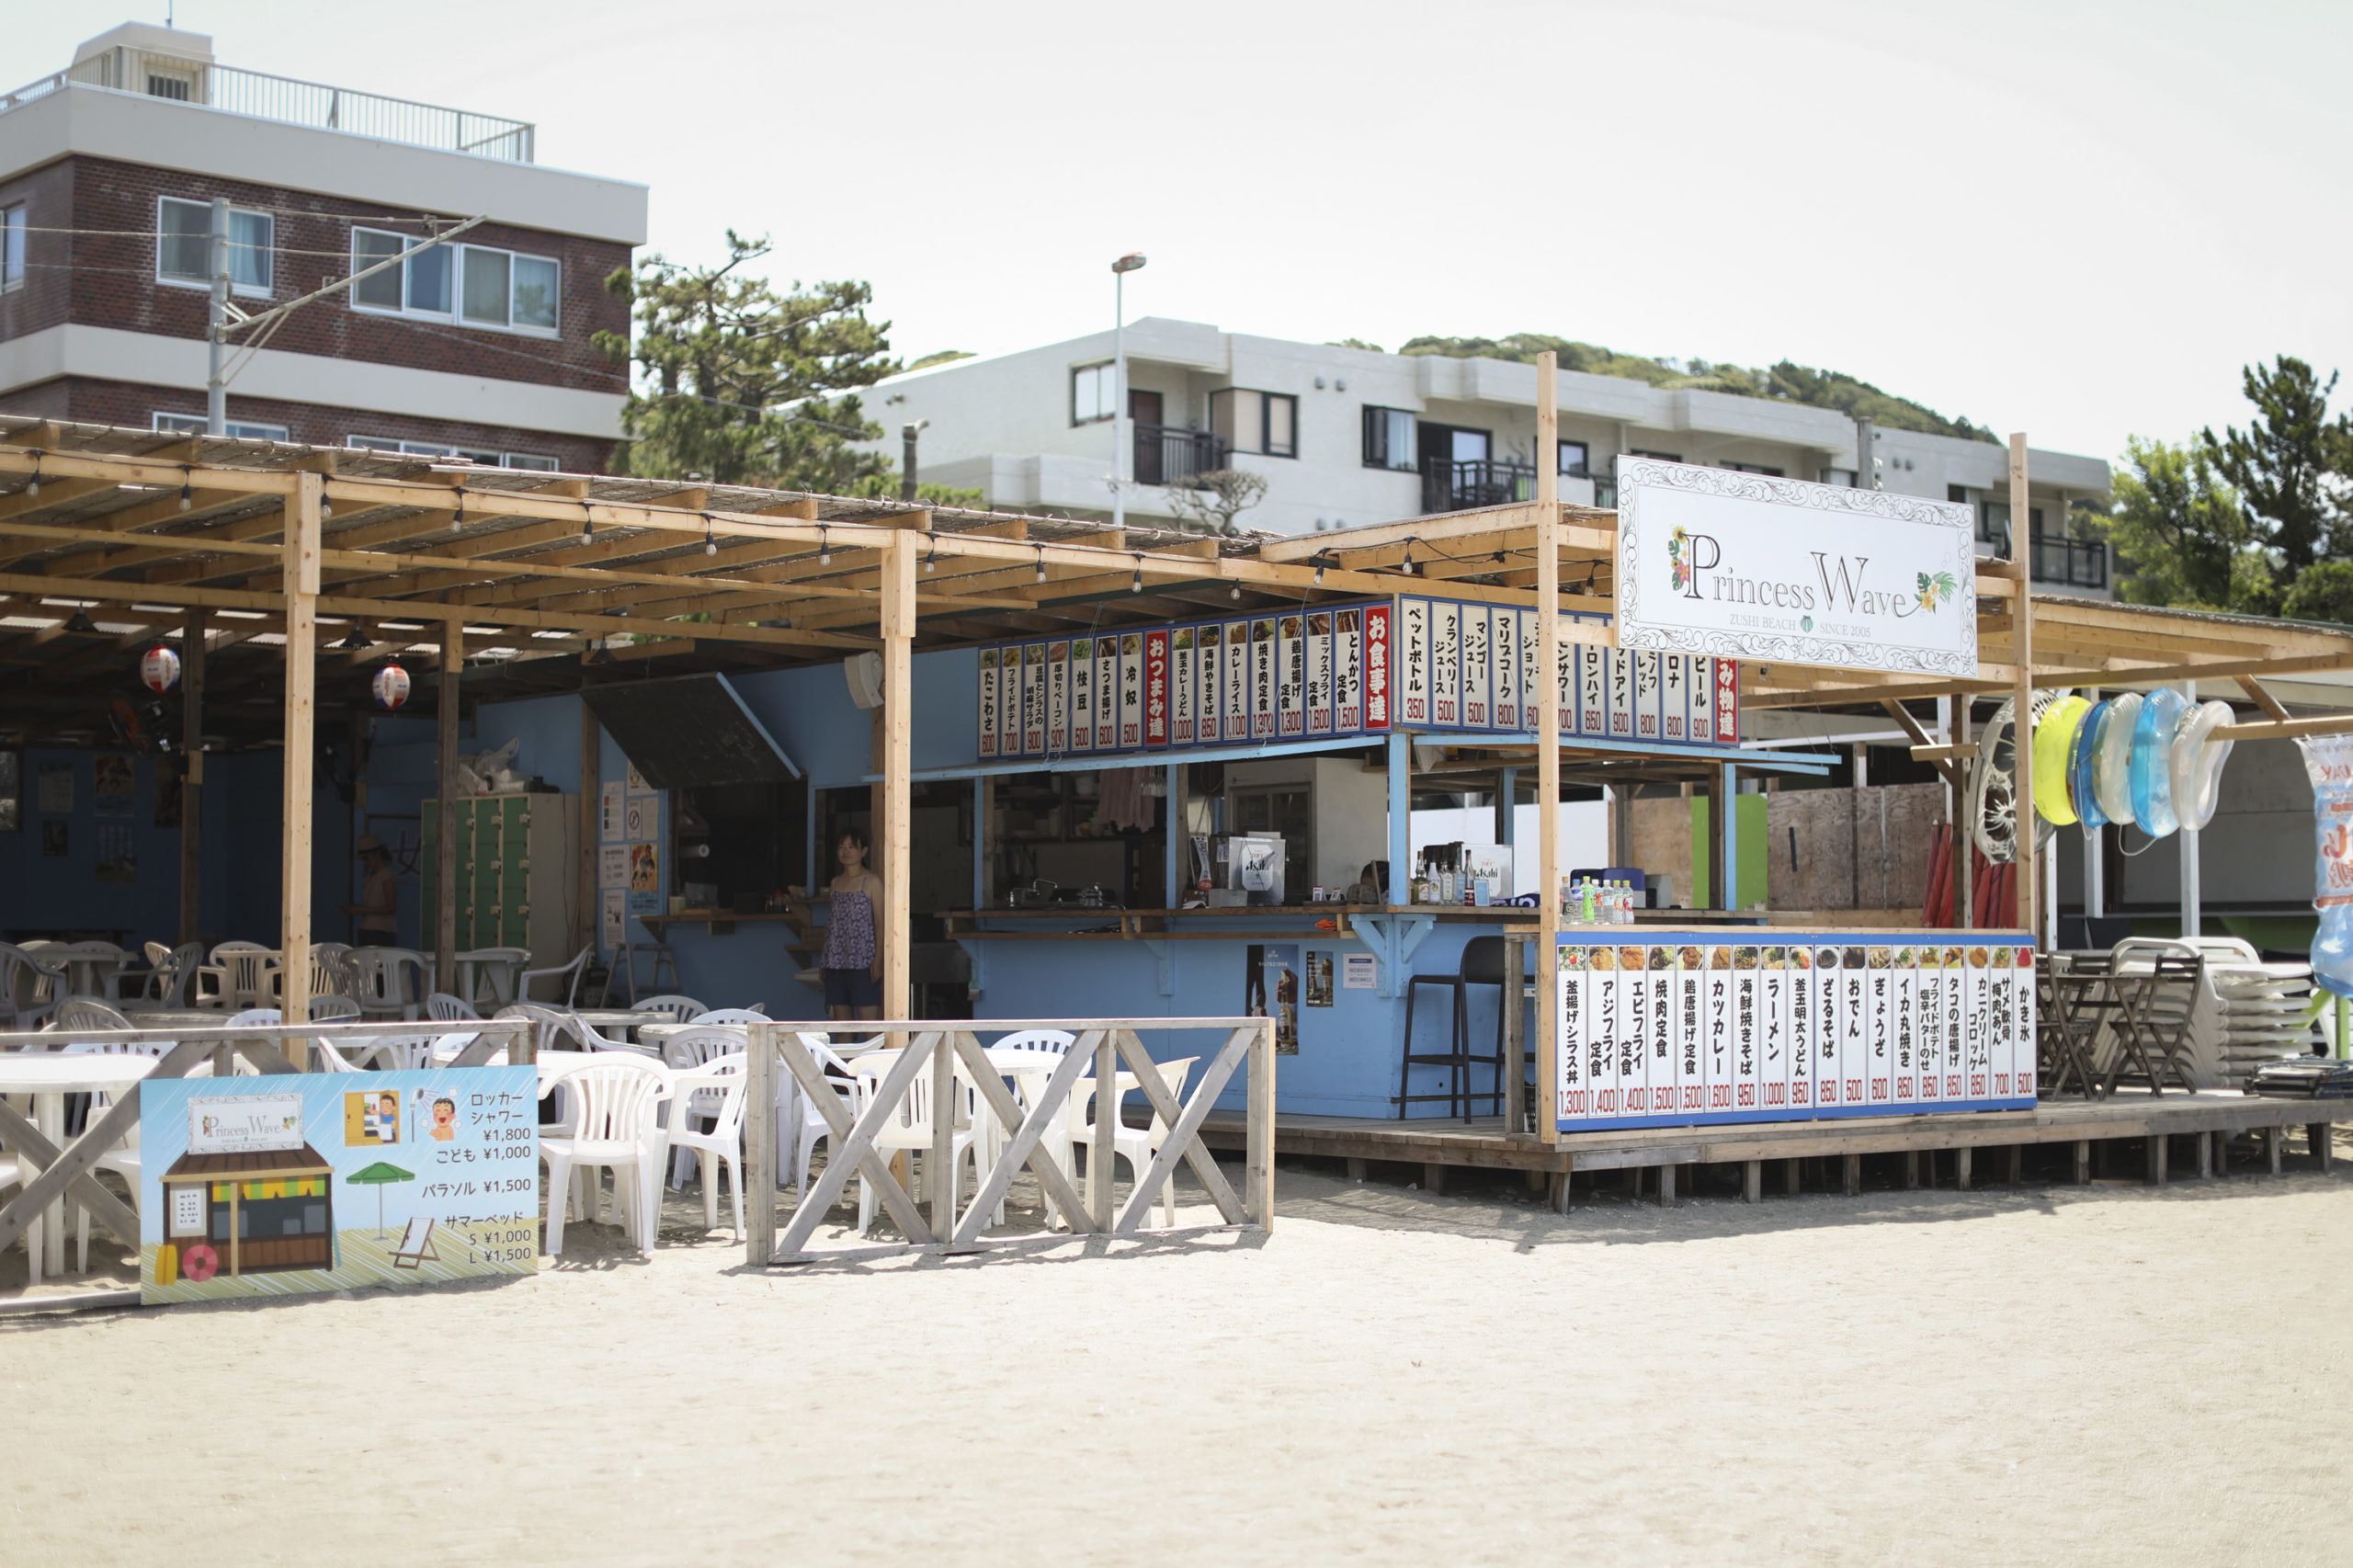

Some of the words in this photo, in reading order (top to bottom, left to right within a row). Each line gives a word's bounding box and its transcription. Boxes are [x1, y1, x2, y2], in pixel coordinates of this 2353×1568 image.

[1683, 533, 1814, 610] Princess
[1810, 551, 1914, 618] Wave
[1730, 614, 1759, 627] ZUSHI
[1762, 617, 1796, 631] BEACH
[1819, 623, 1848, 635] SINCE
[1850, 626, 1870, 637] 2005
[1349, 634, 1358, 691] とんかつ
[1408, 608, 1422, 691] ペットボトル
[1447, 615, 1457, 695] クランベリー
[1476, 621, 1485, 679] マンゴー
[1499, 617, 1511, 699] マリブコーク
[1258, 643, 1267, 711] 焼き肉定食
[1320, 636, 1329, 700] ミックスフライ
[1369, 615, 1386, 722] お食事達
[1435, 641, 1445, 694] ジュース
[1465, 635, 1475, 693] ジュース
[1524, 636, 1533, 694] ショット
[1637, 655, 1646, 698] レッド
[1668, 655, 1679, 689] ロナ
[1076, 670, 1087, 710] 枝豆
[1102, 659, 1110, 722] さつま揚げ
[1149, 639, 1165, 737] おつまみ達
[1178, 651, 1188, 717] 釜玉カレーうどん
[1204, 649, 1213, 715] 海鮮やきそば
[1232, 646, 1240, 714] カレーライス
[1337, 675, 1347, 703] 定食
[1615, 648, 1626, 707] ッドアイ
[1695, 656, 1706, 708] ビール
[984, 671, 994, 731] たこわさ
[1280, 684, 1290, 710] 定食
[1309, 681, 1318, 707] 定食
[1281, 710, 1302, 733] 1,300
[1309, 709, 1329, 732] 1,600
[1337, 706, 1358, 729] 1,500
[1407, 698, 1424, 719] 350
[1438, 700, 1454, 722] 500
[1468, 702, 1484, 723] 500
[1498, 704, 1514, 725] 800
[1586, 710, 1601, 731] 650
[1099, 725, 1113, 745] 600
[1124, 723, 1138, 744] 500
[1201, 717, 1216, 737] 850
[1225, 715, 1245, 738] 1,100
[1613, 712, 1628, 733] 900
[1641, 714, 1655, 734] 800
[1667, 717, 1682, 736] 800
[1694, 718, 1708, 738] 900
[1005, 733, 1017, 752] 700
[1075, 727, 1088, 746] 500
[1655, 979, 1667, 1058] 焼肉定食
[1768, 978, 1779, 1061] ラーメン
[1823, 978, 1835, 1059] ざるそば
[1848, 978, 1860, 1038] おでん
[1875, 977, 1885, 1058] ぎょうざ
[1930, 978, 1938, 1059] フライドポテト
[1992, 982, 2002, 1046] 梅肉あん
[2001, 977, 2010, 1040] サメ軟骨
[2019, 986, 2029, 1042] かき氷
[1566, 980, 1578, 1085] 釜揚げシラス丼
[1602, 981, 1614, 1071] アジフライ
[1632, 982, 1644, 1069] エビフライ
[1684, 979, 1696, 1074] 鶏唐揚げ定食
[1712, 980, 1724, 1074] カツカレー
[1740, 979, 1753, 1075] 海鮮焼きそば
[1794, 978, 1806, 1076] 釜玉明太うどん
[1899, 978, 1911, 1068] イカ丸焼き
[1920, 989, 1930, 1071] 塩辛バターのせ
[1949, 977, 1960, 1067] タコの唐揚げ
[1979, 978, 1987, 1066] カニクリーム
[1969, 1013, 1978, 1072] コロッケ
[1590, 1040, 1602, 1077] 定食
[1620, 1040, 1632, 1076] 定食
[1738, 1084, 1755, 1106] 950
[1763, 1082, 1785, 1107] 1,000
[1792, 1082, 1808, 1104] 950
[1821, 1080, 1836, 1102] 850
[1847, 1079, 1862, 1101] 500
[1872, 1078, 1887, 1100] 600
[1897, 1076, 1913, 1098] 850
[1923, 1076, 1938, 1097] 850
[1947, 1074, 1961, 1096] 850
[1971, 1074, 1985, 1096] 850
[1995, 1074, 2009, 1095] 700
[2018, 1073, 2031, 1094] 500
[472, 1091, 523, 1106] ロッカー
[1560, 1090, 1585, 1116] 1,300
[1590, 1089, 1615, 1114] 1,400
[1620, 1087, 1644, 1112] 1,400
[1650, 1086, 1674, 1111] 1,500
[1678, 1085, 1702, 1110] 1,500
[1707, 1085, 1730, 1109] 1,600
[207, 1116, 249, 1137] Princess
[247, 1115, 279, 1133] Wave
[472, 1110, 523, 1125] シャワー
[483, 1128, 530, 1142] ¥1,800
[437, 1149, 475, 1164] こども
[483, 1146, 530, 1160] ¥1,000
[422, 1181, 476, 1199] パラソル
[483, 1178, 530, 1194] ¥1,500
[445, 1211, 523, 1230] サマーベッド
[470, 1233, 477, 1245] S
[484, 1229, 531, 1244] ¥1,000
[470, 1252, 476, 1264] L
[484, 1247, 531, 1263] ¥1,500
